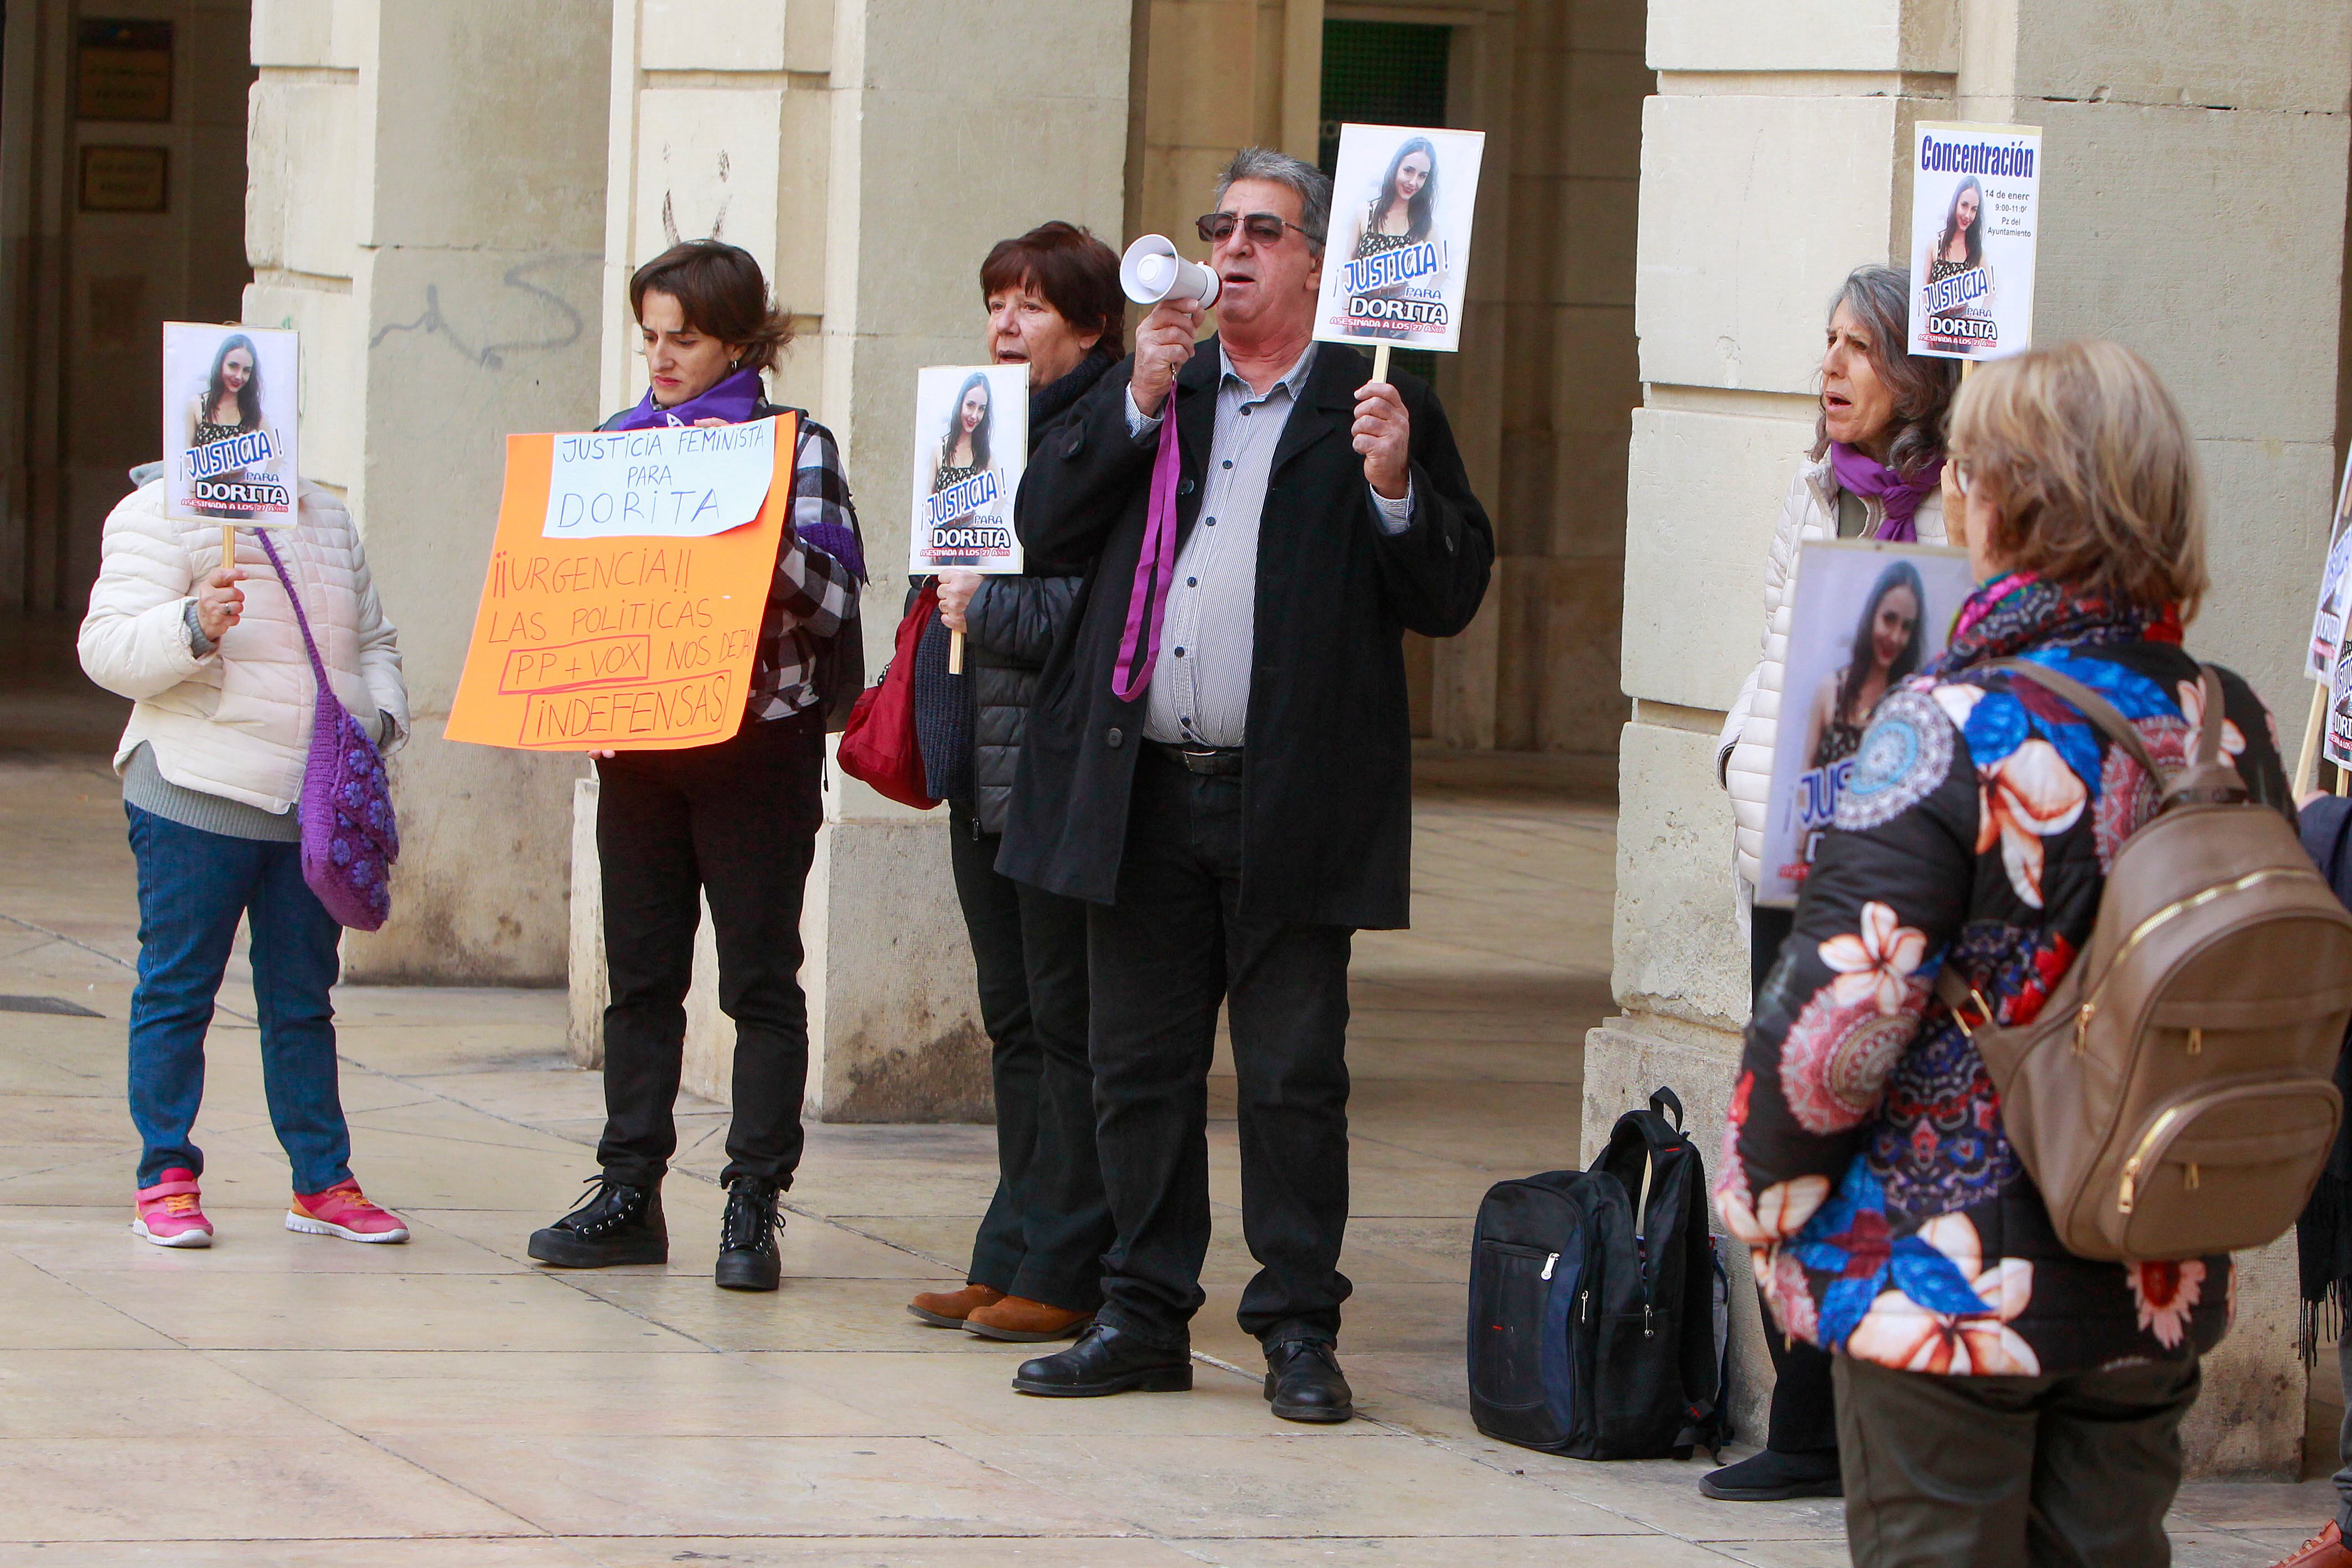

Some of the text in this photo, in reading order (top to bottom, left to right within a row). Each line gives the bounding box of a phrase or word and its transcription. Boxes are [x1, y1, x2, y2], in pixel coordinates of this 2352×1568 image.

[1921, 134, 2034, 178] Concentración
[1985, 189, 1994, 198] 14
[1996, 190, 2005, 199] de
[1987, 227, 2031, 237] Ayuntamiento
[1405, 287, 1441, 299] PARA
[1348, 296, 1449, 325] DORITA
[1967, 307, 1992, 317] PARA
[1330, 318, 1381, 328] ASESINADA
[1392, 322, 1410, 330] LOS
[1424, 324, 1446, 333] AÑOS
[1929, 316, 1998, 340] DORITA
[1918, 334, 1952, 343] ASESINADA
[562, 424, 764, 463] JUSTICIA FEMINISTA
[246, 472, 280, 482] PARA
[627, 465, 673, 489] PARA
[181, 499, 228, 510] ASESINADA
[195, 480, 290, 505] DORITA
[557, 488, 720, 528] DORITA
[974, 515, 1003, 525] PARA
[932, 527, 1011, 548] DORITA
[920, 548, 957, 557] ASESINADA
[991, 548, 1010, 557] AÑOS
[493, 548, 691, 599] ¡¡URGENCIA!!
[488, 611, 547, 643] LAS
[516, 653, 557, 685] PP
[565, 656, 581, 680] +
[591, 642, 641, 677] VOX
[666, 635, 711, 670] NOS
[536, 675, 726, 738] INDEFENSAS
[2334, 710, 2352, 741] DORI
